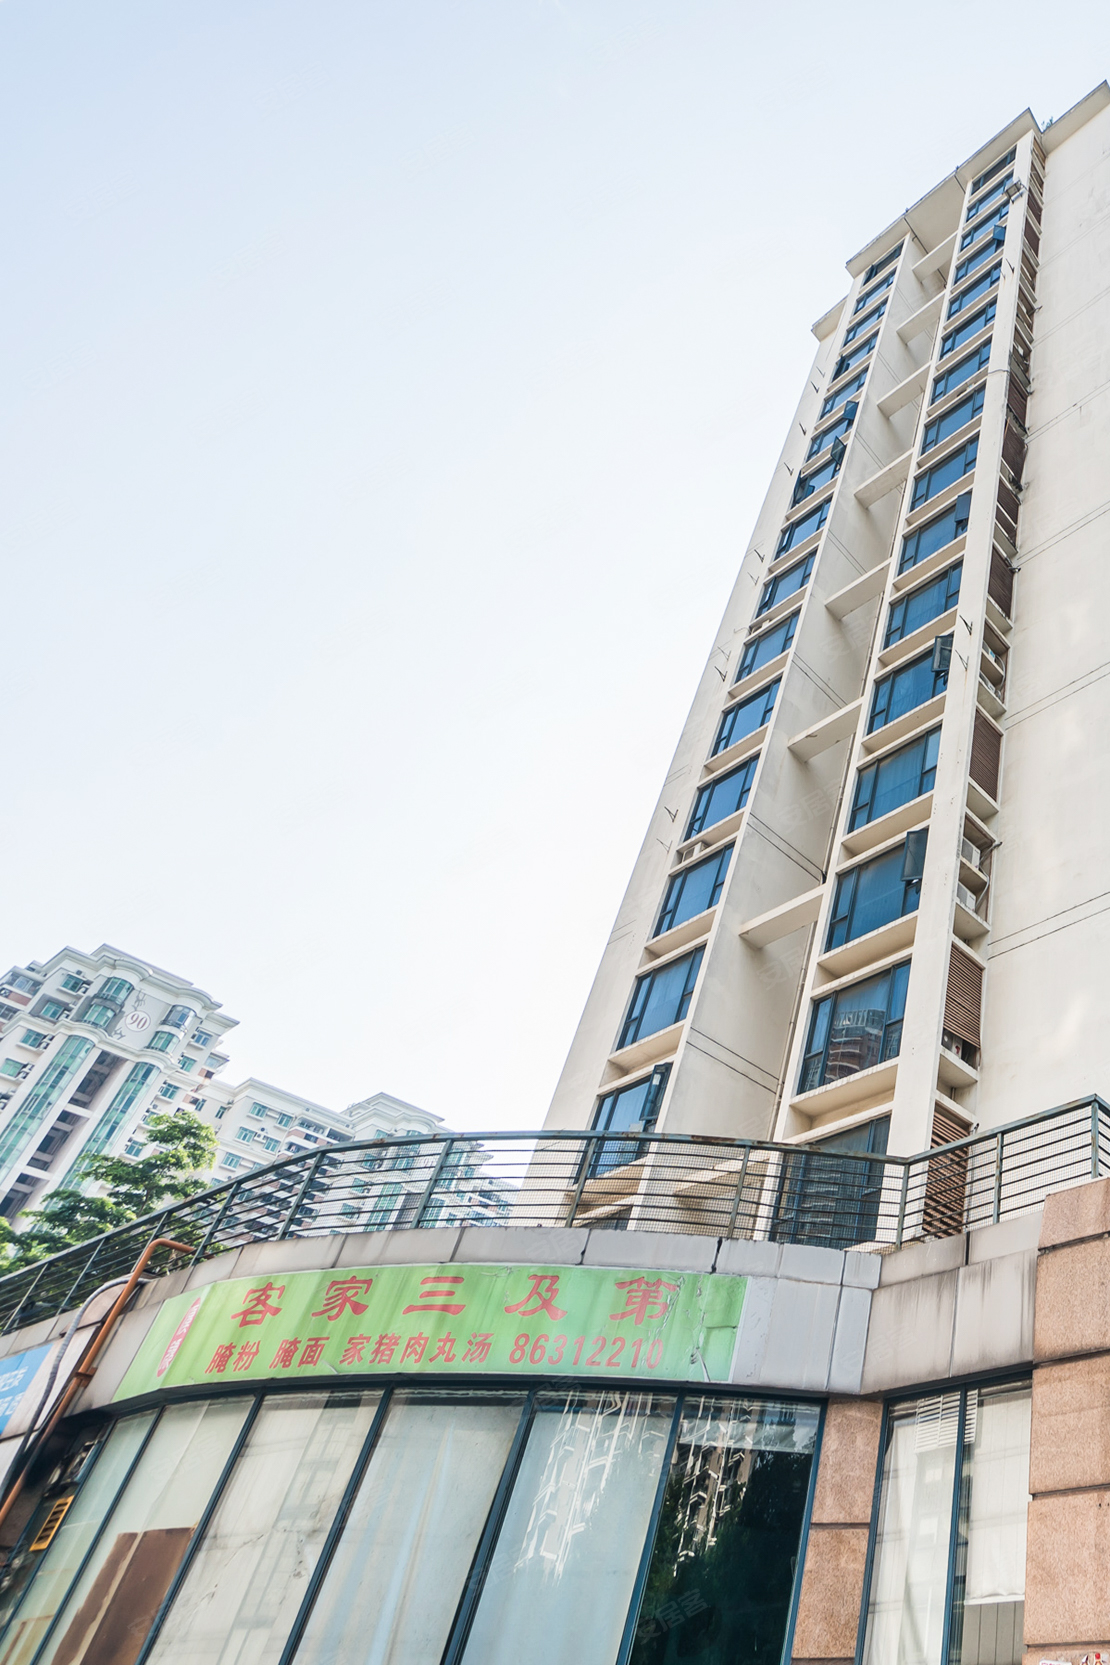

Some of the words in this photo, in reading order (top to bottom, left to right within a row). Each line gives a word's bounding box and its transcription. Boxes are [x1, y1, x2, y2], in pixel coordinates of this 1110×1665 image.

[128, 1012, 148, 1030] 90
[230, 1274, 680, 1328] 客家三及第
[204, 1340, 261, 1375] 腌粉
[268, 1336, 331, 1370] 腌面
[339, 1331, 495, 1366] 家猪肉丸汤
[508, 1332, 665, 1370] 86312210
